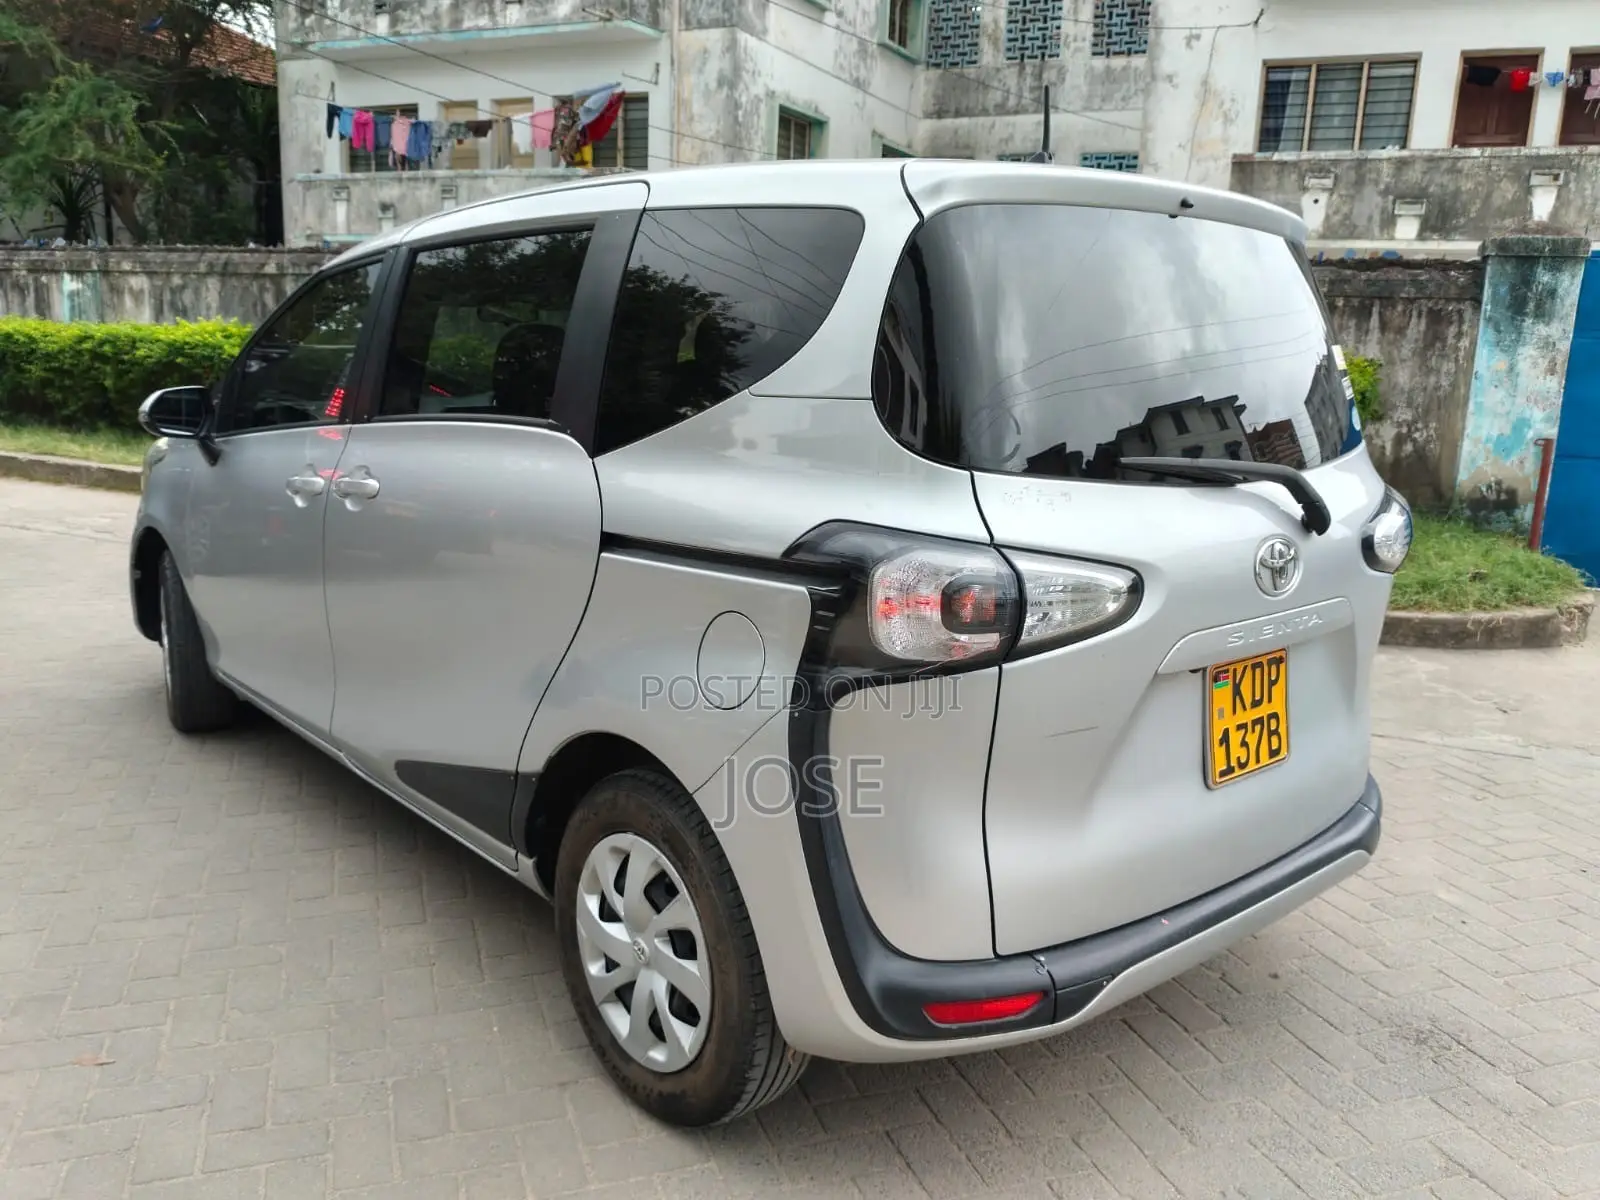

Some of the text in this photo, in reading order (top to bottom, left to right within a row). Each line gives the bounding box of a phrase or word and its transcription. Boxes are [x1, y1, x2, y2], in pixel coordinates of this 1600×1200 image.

[1227, 614, 1323, 647] SIENTA
[1232, 657, 1281, 716] KDP
[1218, 712, 1282, 778] 137B
